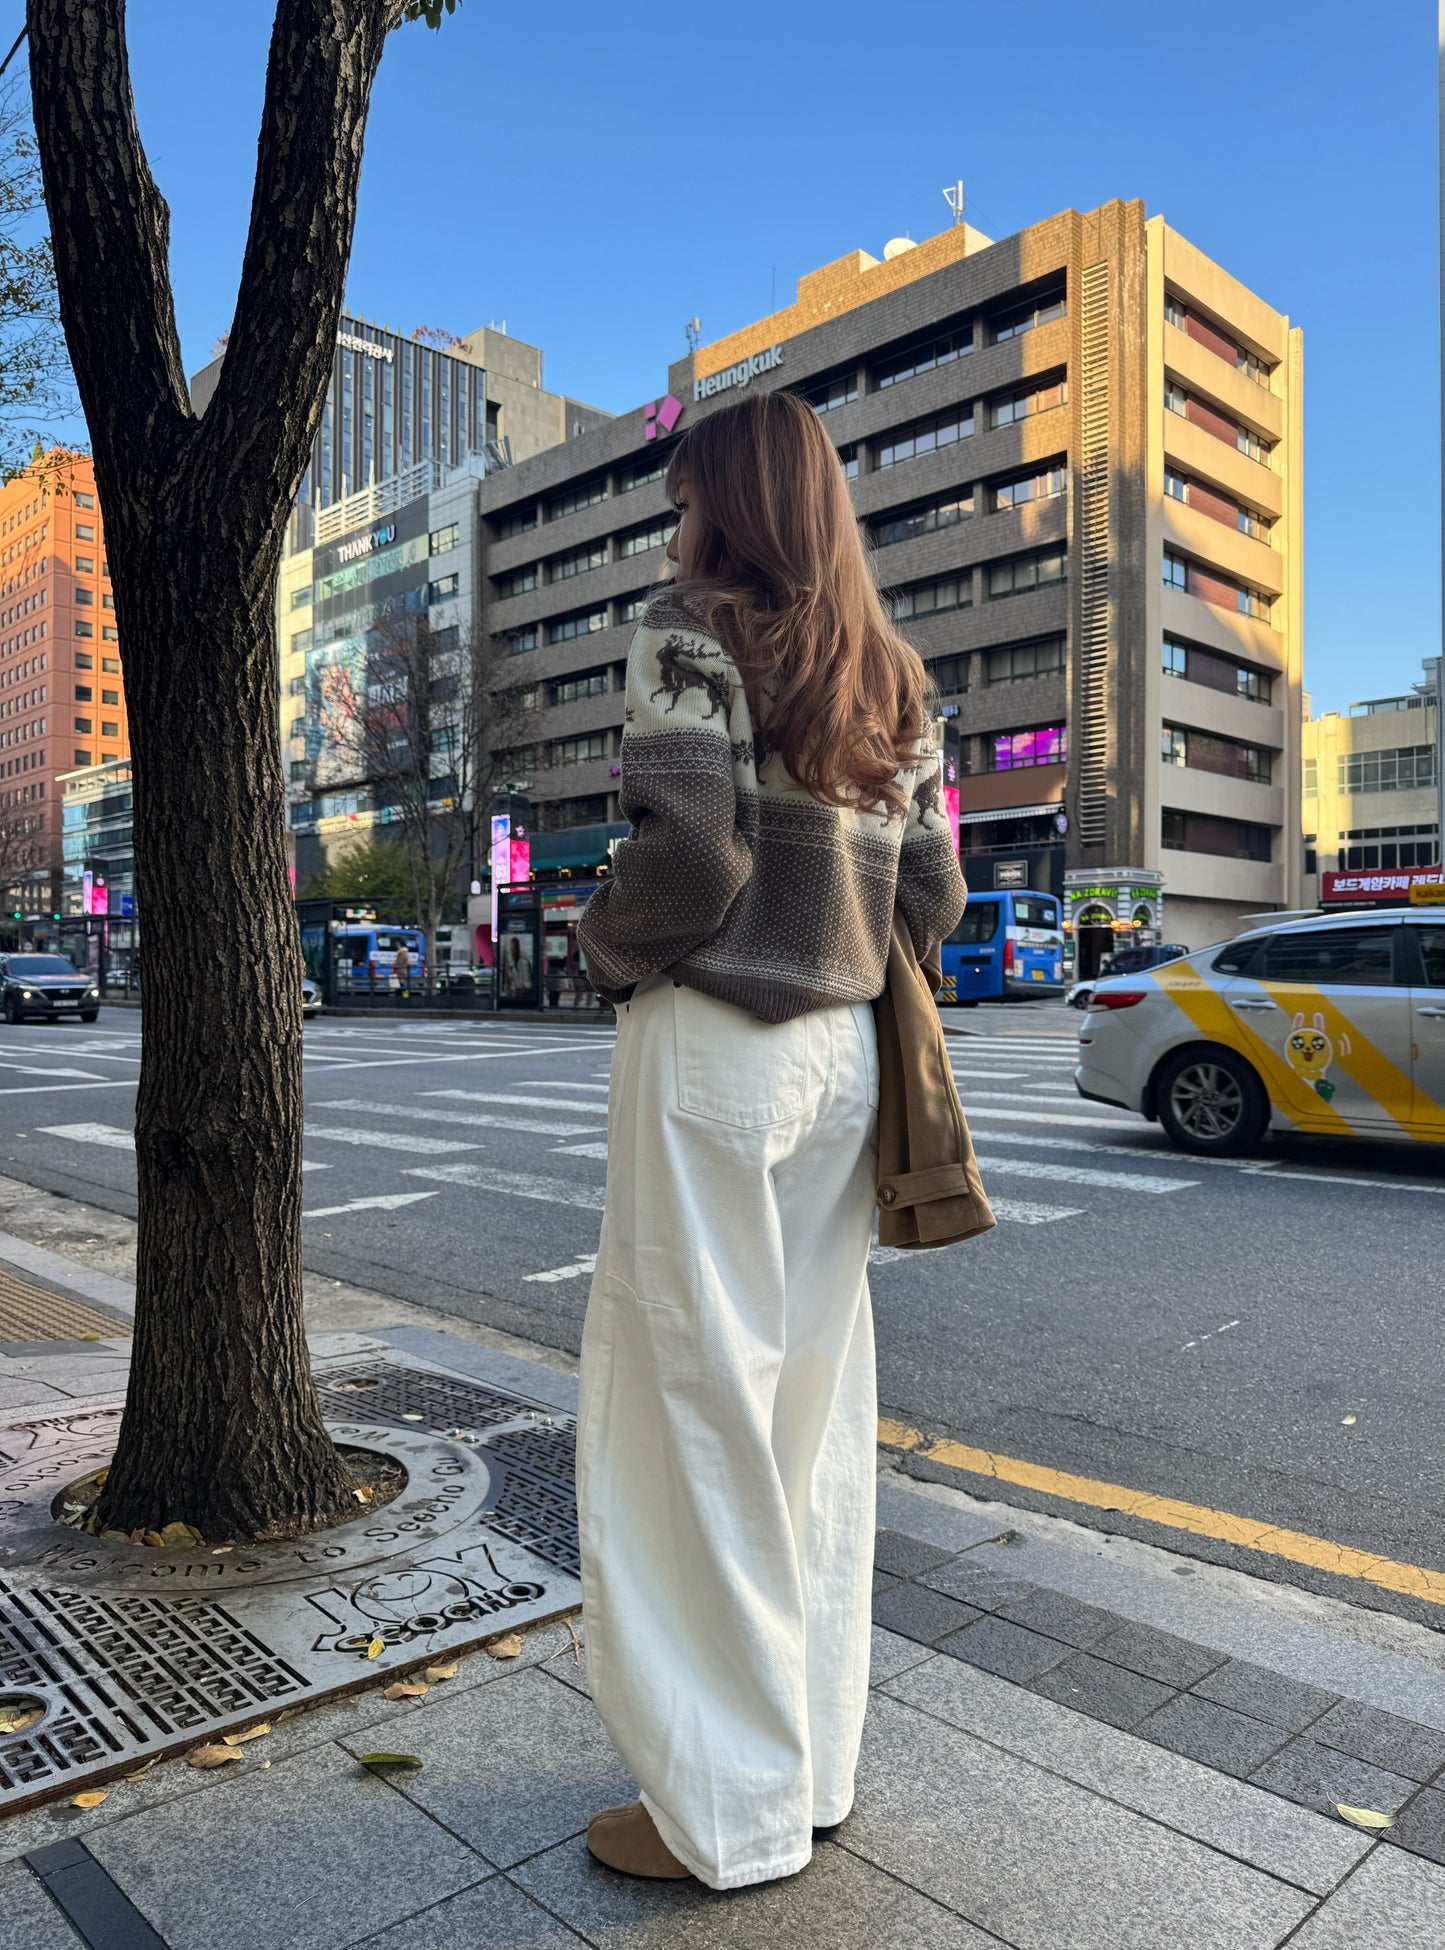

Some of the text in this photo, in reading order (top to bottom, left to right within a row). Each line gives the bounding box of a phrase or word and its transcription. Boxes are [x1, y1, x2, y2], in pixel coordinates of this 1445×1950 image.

[693, 344, 784, 401] Heungkuk
[337, 524, 395, 563] THANK YOU
[1332, 875, 1410, 892] 보드게임카페
[36, 1543, 262, 1577] Welcome
[294, 1546, 346, 1563] to
[432, 1456, 464, 1476] Gu
